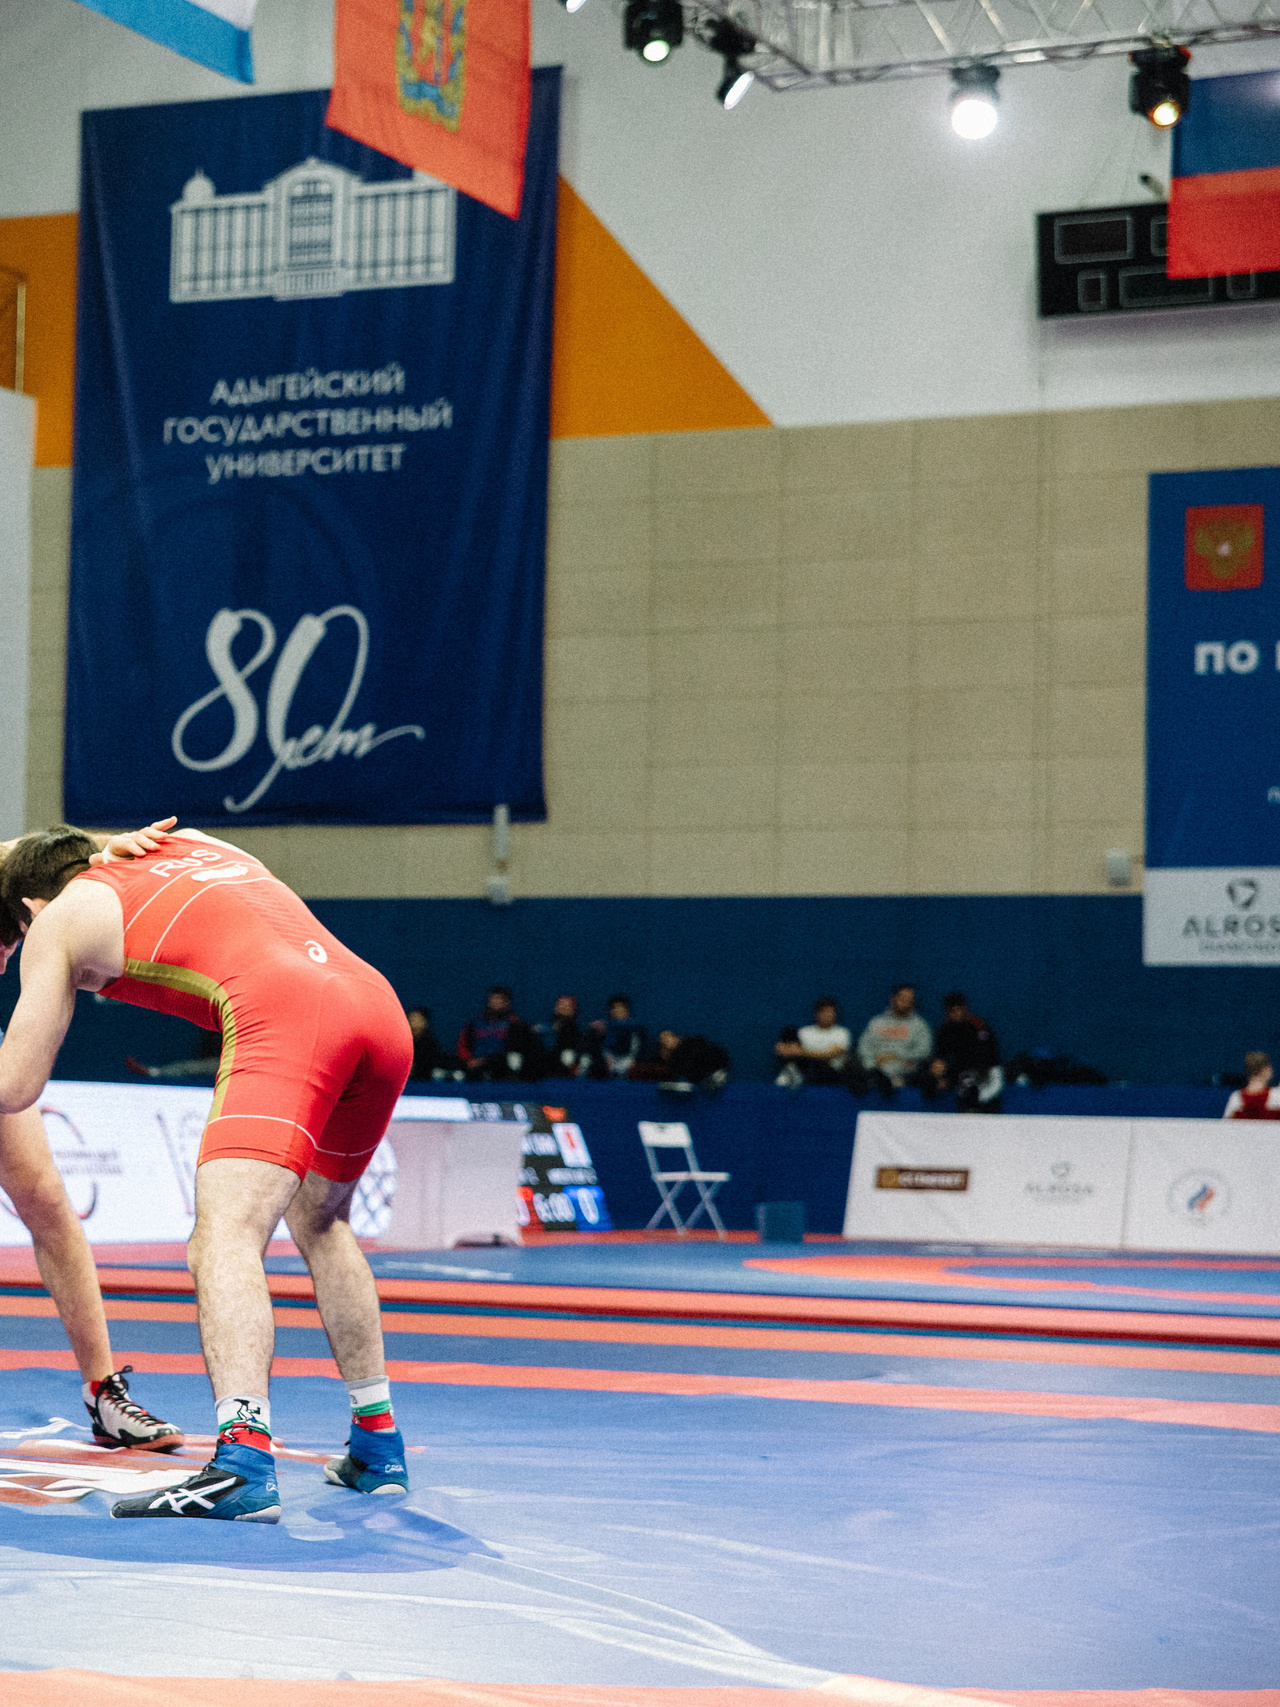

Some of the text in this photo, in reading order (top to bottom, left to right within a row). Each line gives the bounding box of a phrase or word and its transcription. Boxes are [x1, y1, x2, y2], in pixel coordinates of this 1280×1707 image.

[210, 361, 406, 407] АДЫГЕЙСКИЙ
[163, 397, 453, 446] ГОСУДАРСТВЕННЫЙ
[206, 442, 407, 485] УНИВЕРСИТЕТ
[171, 604, 370, 773] 80
[148, 848, 222, 878] RUS
